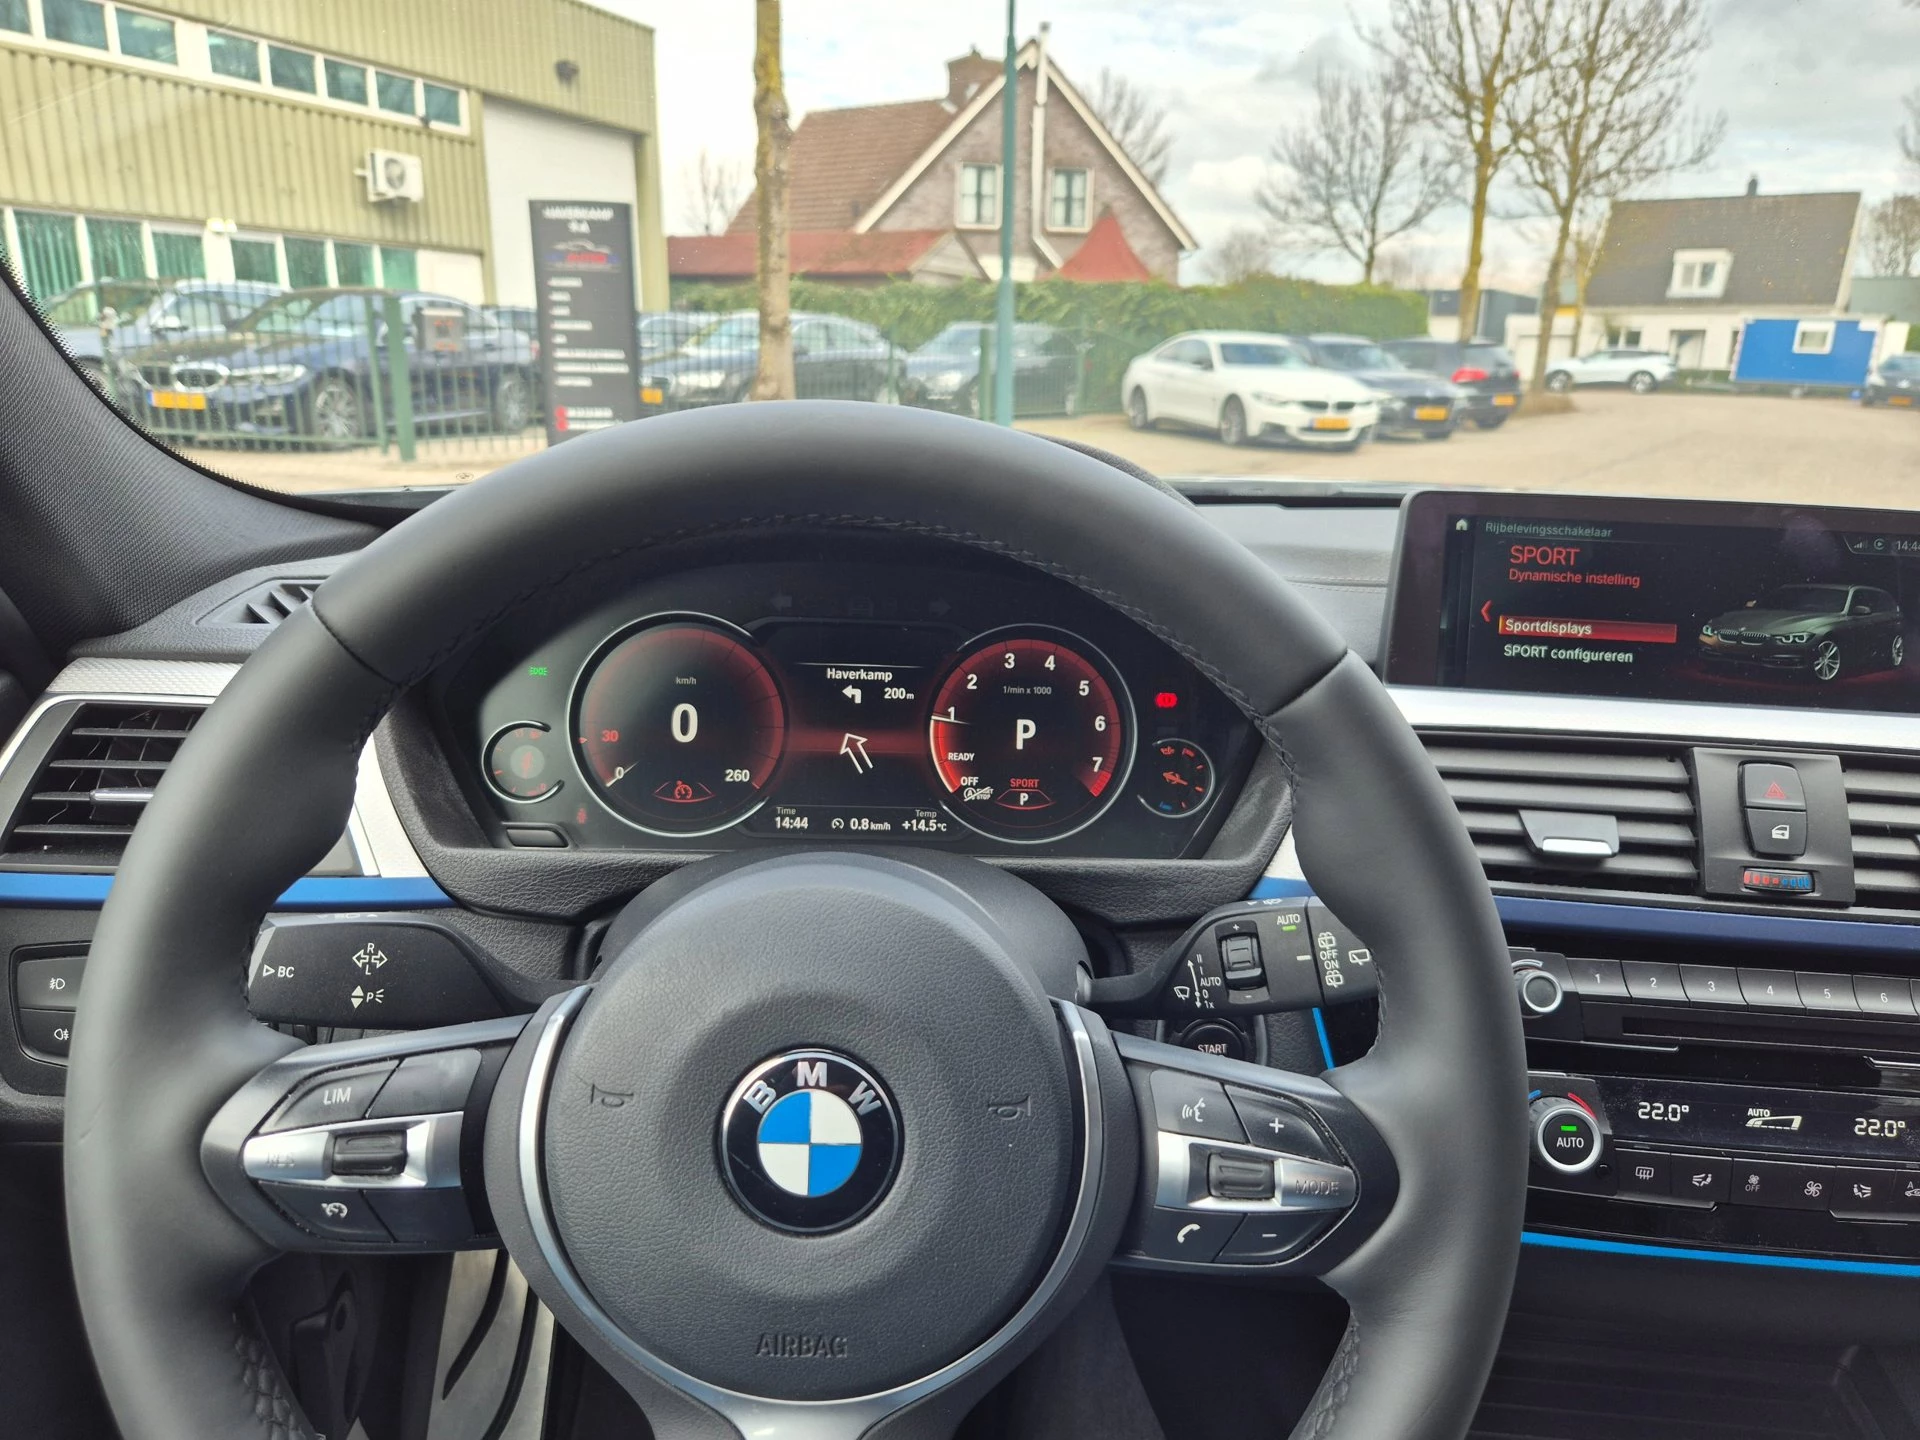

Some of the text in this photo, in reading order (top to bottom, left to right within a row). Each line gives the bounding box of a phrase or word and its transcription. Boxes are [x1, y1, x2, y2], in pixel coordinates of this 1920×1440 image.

[1485, 521, 1613, 537] Rijbelevingsschakelaar
[1510, 545, 1581, 566] SPORT
[1509, 568, 1640, 588] Dynamische instelling
[1505, 618, 1593, 636] Sportdisplays
[1504, 644, 1634, 663] SPORT configureren
[1004, 653, 1015, 669] 3
[1044, 654, 1056, 670] 4
[676, 676, 697, 685] km/h
[826, 668, 893, 682] Haverkamp
[966, 674, 978, 690] 2
[1079, 680, 1090, 696] 5
[1003, 686, 1025, 694] 1/min
[1033, 686, 1052, 694] 1000
[947, 706, 956, 720] 1
[671, 703, 698, 743] 0
[1094, 715, 1106, 732] 6
[602, 730, 620, 742] 30
[1016, 718, 1037, 750] P
[948, 752, 976, 761] READY
[1092, 756, 1104, 772] 7
[614, 766, 625, 779] 0
[724, 768, 750, 782] 260
[960, 776, 980, 786] OFF
[1010, 778, 1040, 788] SPORT
[1020, 792, 1029, 806] P
[776, 806, 797, 816] Time
[914, 809, 937, 819] Temp
[774, 816, 809, 830] 14:44
[1276, 914, 1301, 926] AUTO
[366, 942, 375, 954] R
[1320, 949, 1338, 960] OFF
[365, 964, 372, 976] L
[1324, 959, 1339, 970] ON
[277, 965, 295, 978] BC
[1200, 976, 1222, 986] AUTO
[1594, 973, 1600, 984] 1
[1650, 977, 1658, 988] 2
[1708, 981, 1716, 992] 3
[1766, 984, 1774, 996] 4
[366, 992, 375, 1003] P
[1824, 988, 1832, 1000] 5
[1880, 992, 1889, 1004] 6
[1204, 1000, 1215, 1010] 1x
[1198, 1043, 1227, 1056] START
[742, 1061, 882, 1116] BMW
[322, 1087, 352, 1106] LIM
[1748, 1108, 1771, 1118] AUTO
[1556, 1136, 1585, 1148] AUTO
[1295, 1179, 1340, 1196] MODE
[1744, 1184, 1761, 1193] OFF
[755, 1333, 848, 1358] AIRBAG
